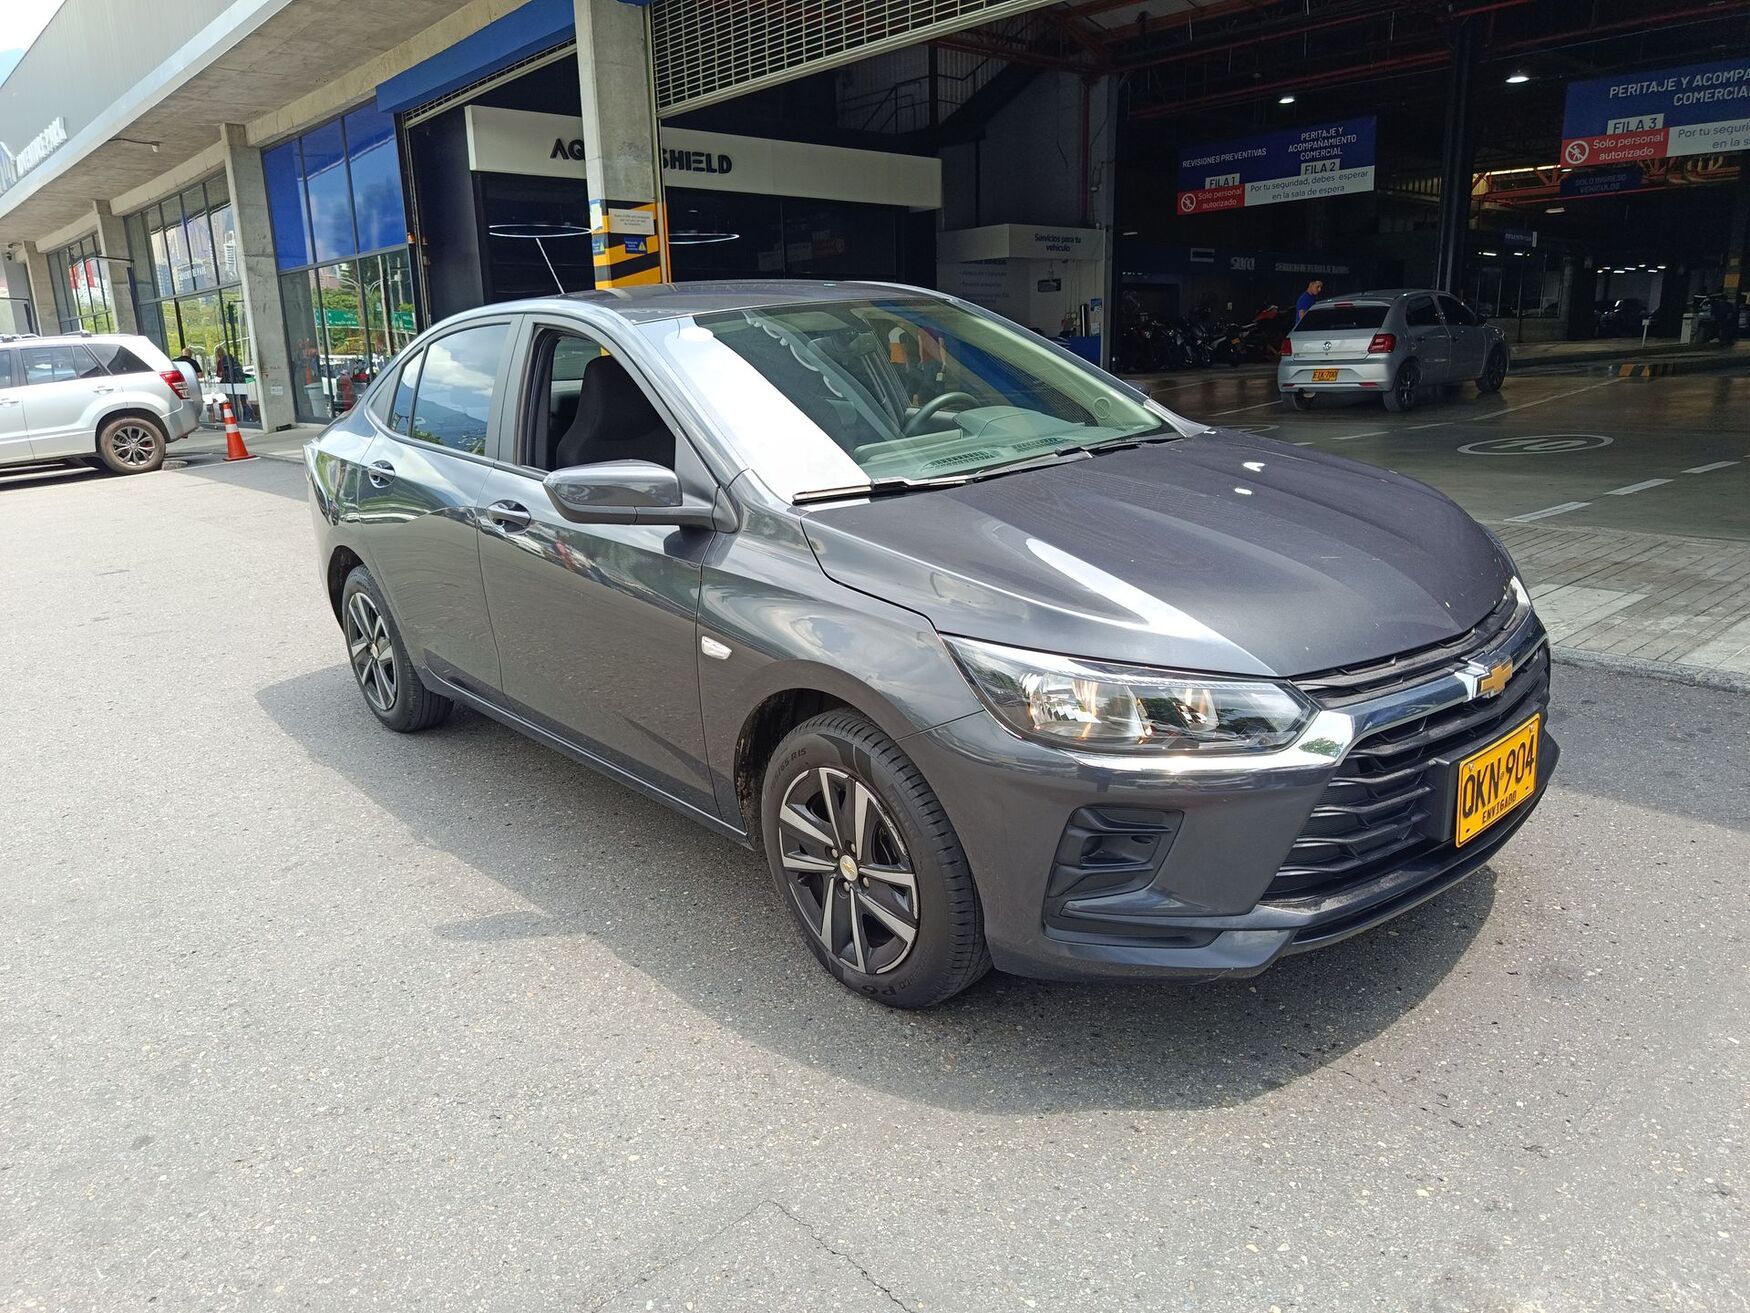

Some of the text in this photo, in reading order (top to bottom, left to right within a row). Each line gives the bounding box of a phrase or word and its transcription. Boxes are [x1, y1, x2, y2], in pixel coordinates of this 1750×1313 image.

[1609, 78, 1677, 99] PERITAJE
[1680, 76, 1690, 88] Y
[1613, 118, 1657, 133] FILA 3
[1301, 128, 1337, 141] PERITAJE
[1678, 129, 1697, 138] Por
[1699, 127, 1710, 135] tu
[1288, 134, 1357, 153] ACOMPAÑAMIENTO
[1593, 132, 1664, 149] Solo personal
[1712, 140, 1727, 149] en
[1730, 137, 1740, 147] la
[1182, 147, 1267, 168] REVISIONES PREVENTIVAS
[1300, 149, 1343, 160] COMERCIAL
[1599, 147, 1654, 161] autorizado
[661, 148, 732, 174] SHIELD
[1304, 162, 1336, 175] FILA 2
[1210, 178, 1229, 187] FILA
[1250, 184, 1262, 192] Por
[1311, 175, 1335, 184] debes
[1338, 170, 1369, 182] esperar
[1198, 188, 1242, 200] Solo personal
[1282, 191, 1290, 199] la
[1291, 190, 1306, 198] sala
[1307, 187, 1317, 195] de
[1318, 186, 1345, 196] espera
[1202, 199, 1237, 209] autorizado
[1481, 790, 1517, 824] ENVIGADO
